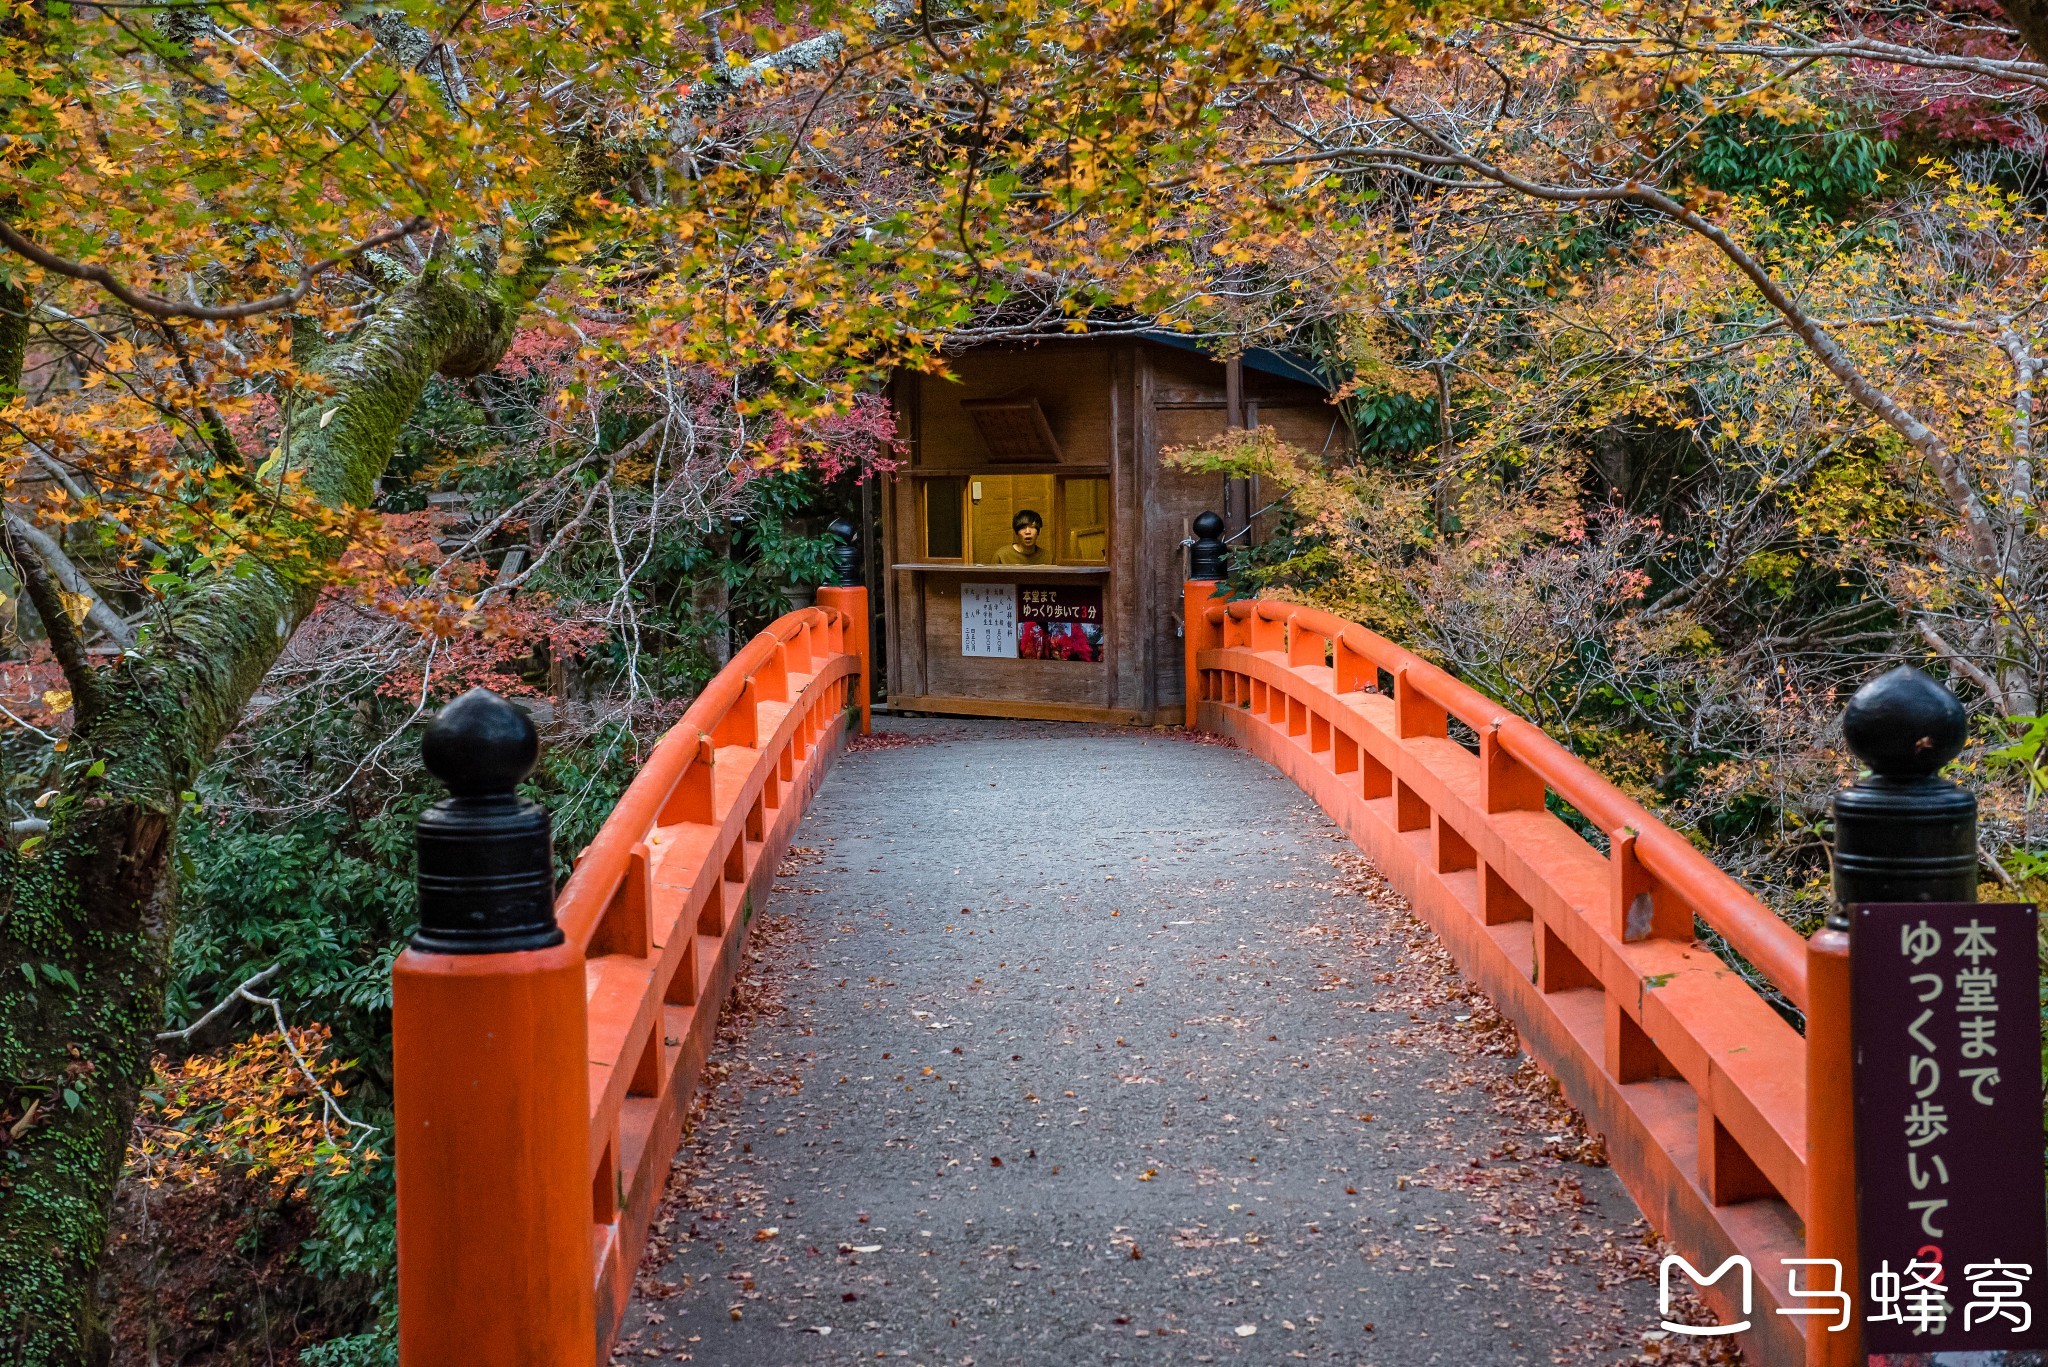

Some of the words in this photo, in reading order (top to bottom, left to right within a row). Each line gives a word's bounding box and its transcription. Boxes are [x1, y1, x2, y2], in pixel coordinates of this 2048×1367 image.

[1023, 591, 1057, 603] 本堂まで
[1023, 604, 1097, 619] ゆっくり歩いて3分
[1953, 919, 2001, 1106] 本堂まで
